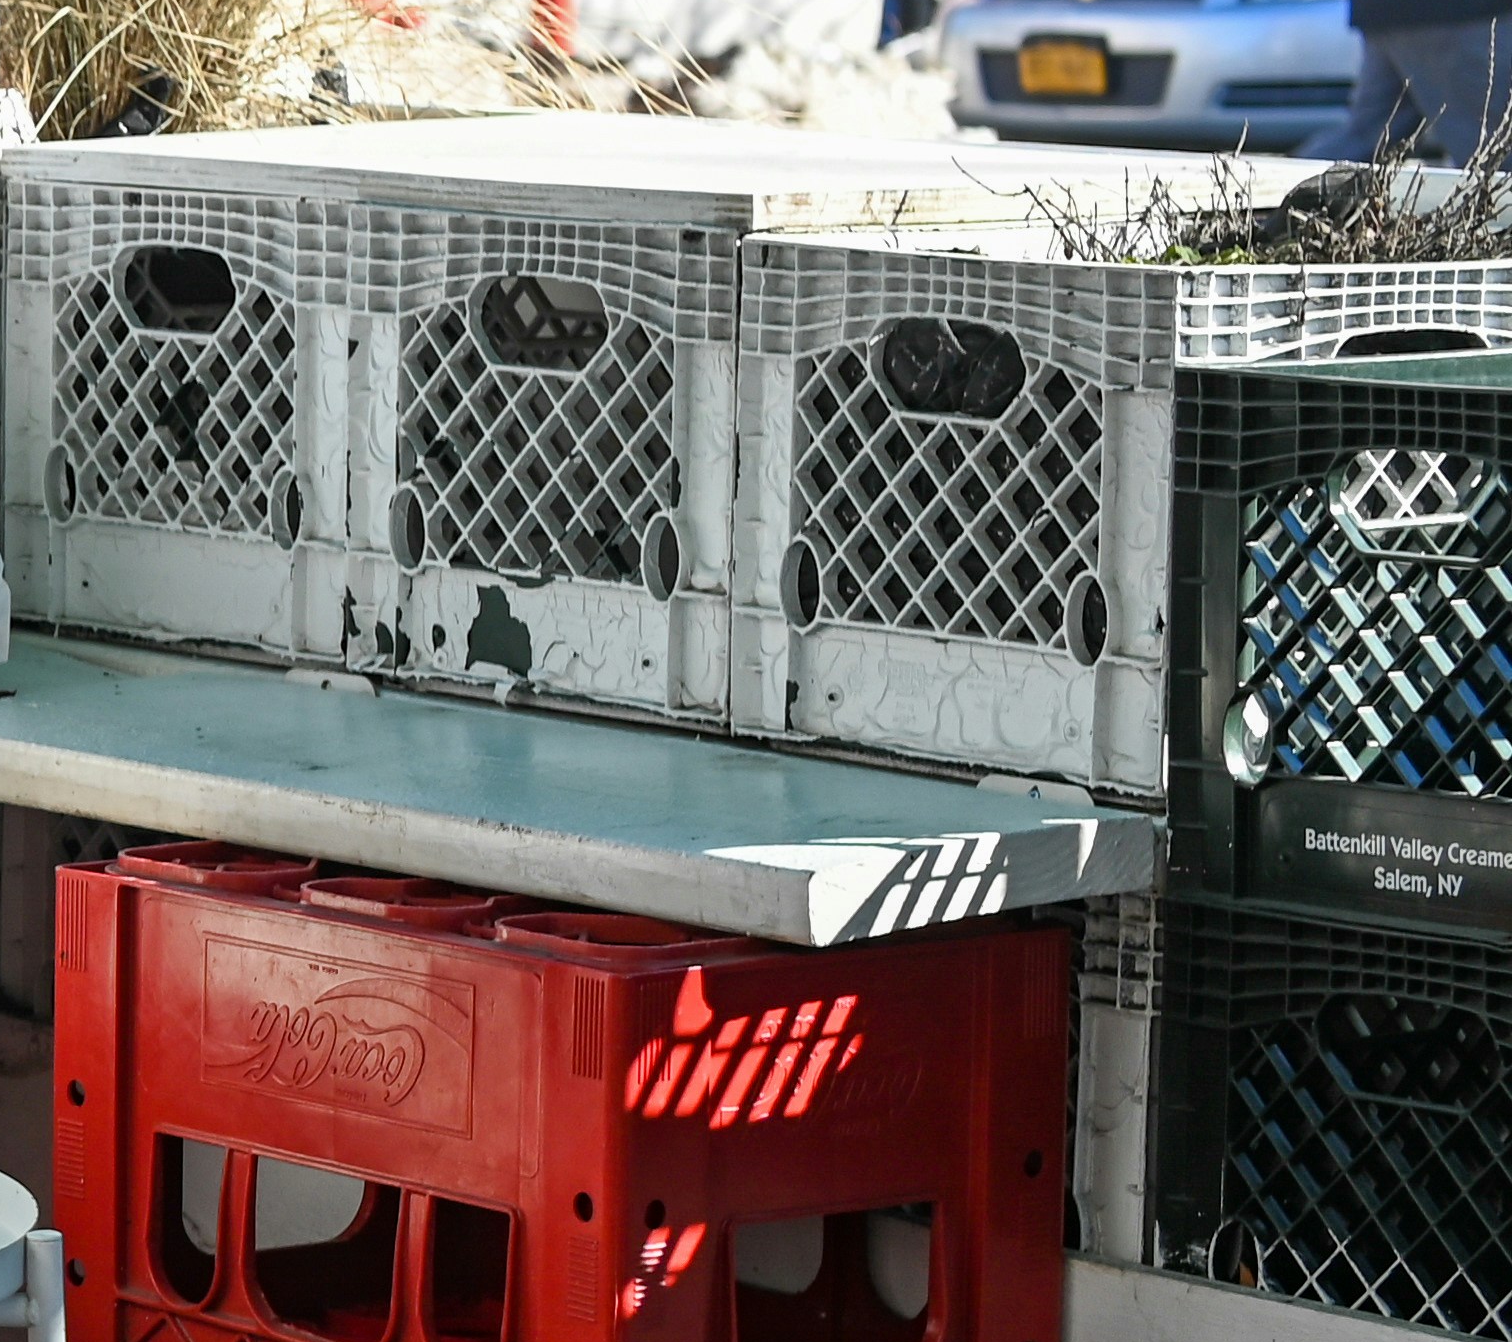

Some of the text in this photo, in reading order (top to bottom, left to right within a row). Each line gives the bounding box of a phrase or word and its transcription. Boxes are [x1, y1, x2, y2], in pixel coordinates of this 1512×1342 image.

[1304, 827, 1512, 870] Battenkill Valley Creame
[1373, 865, 1464, 898] Salem, NY
